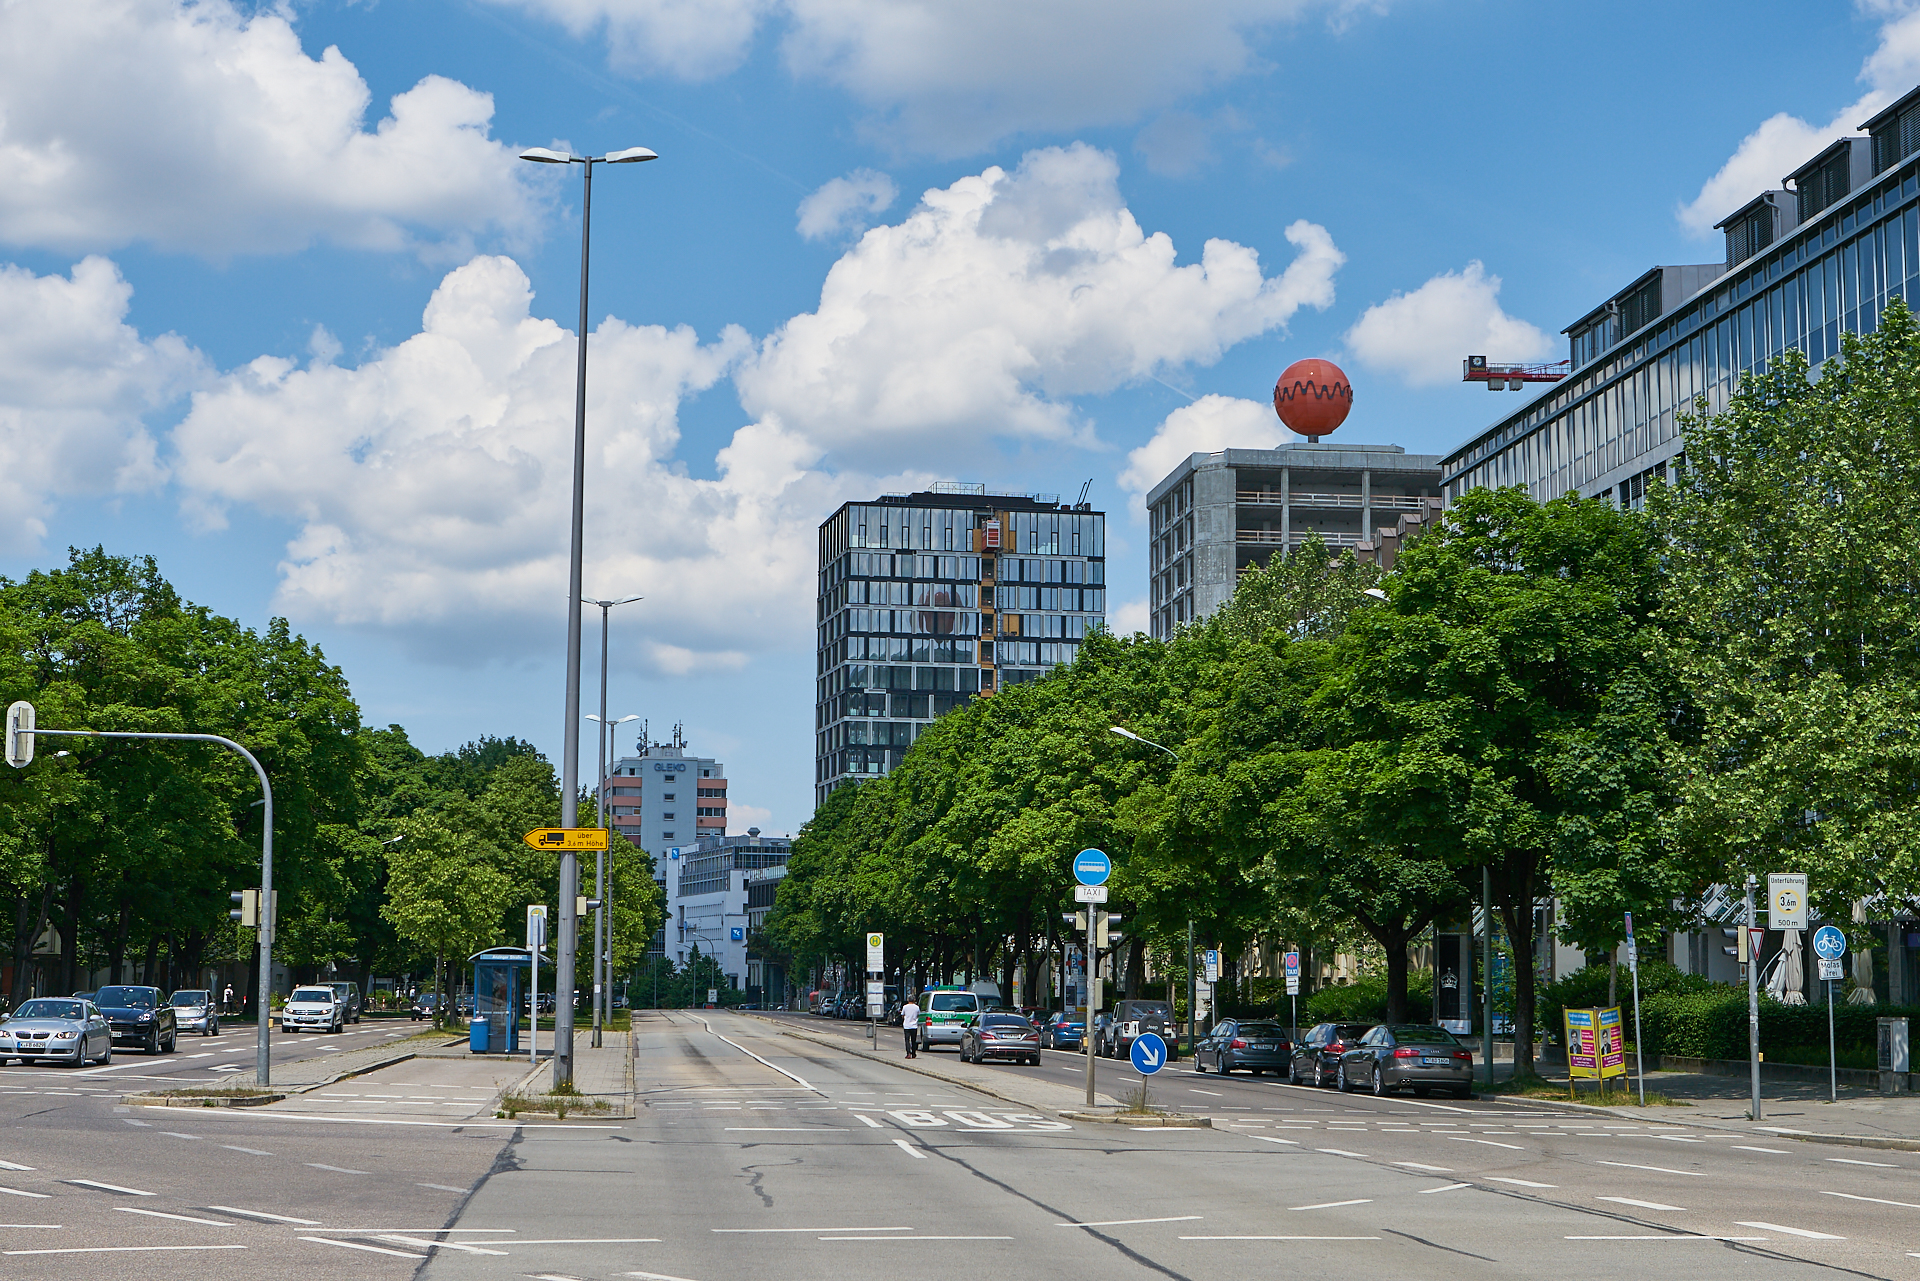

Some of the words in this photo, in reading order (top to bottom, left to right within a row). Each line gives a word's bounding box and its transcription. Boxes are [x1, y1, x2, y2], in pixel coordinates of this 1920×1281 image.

[654, 762, 686, 772] GLEKO
[1770, 877, 1805, 886] Unterführung
[1083, 888, 1101, 896] TAXI
[885, 1110, 1073, 1130] BUS
